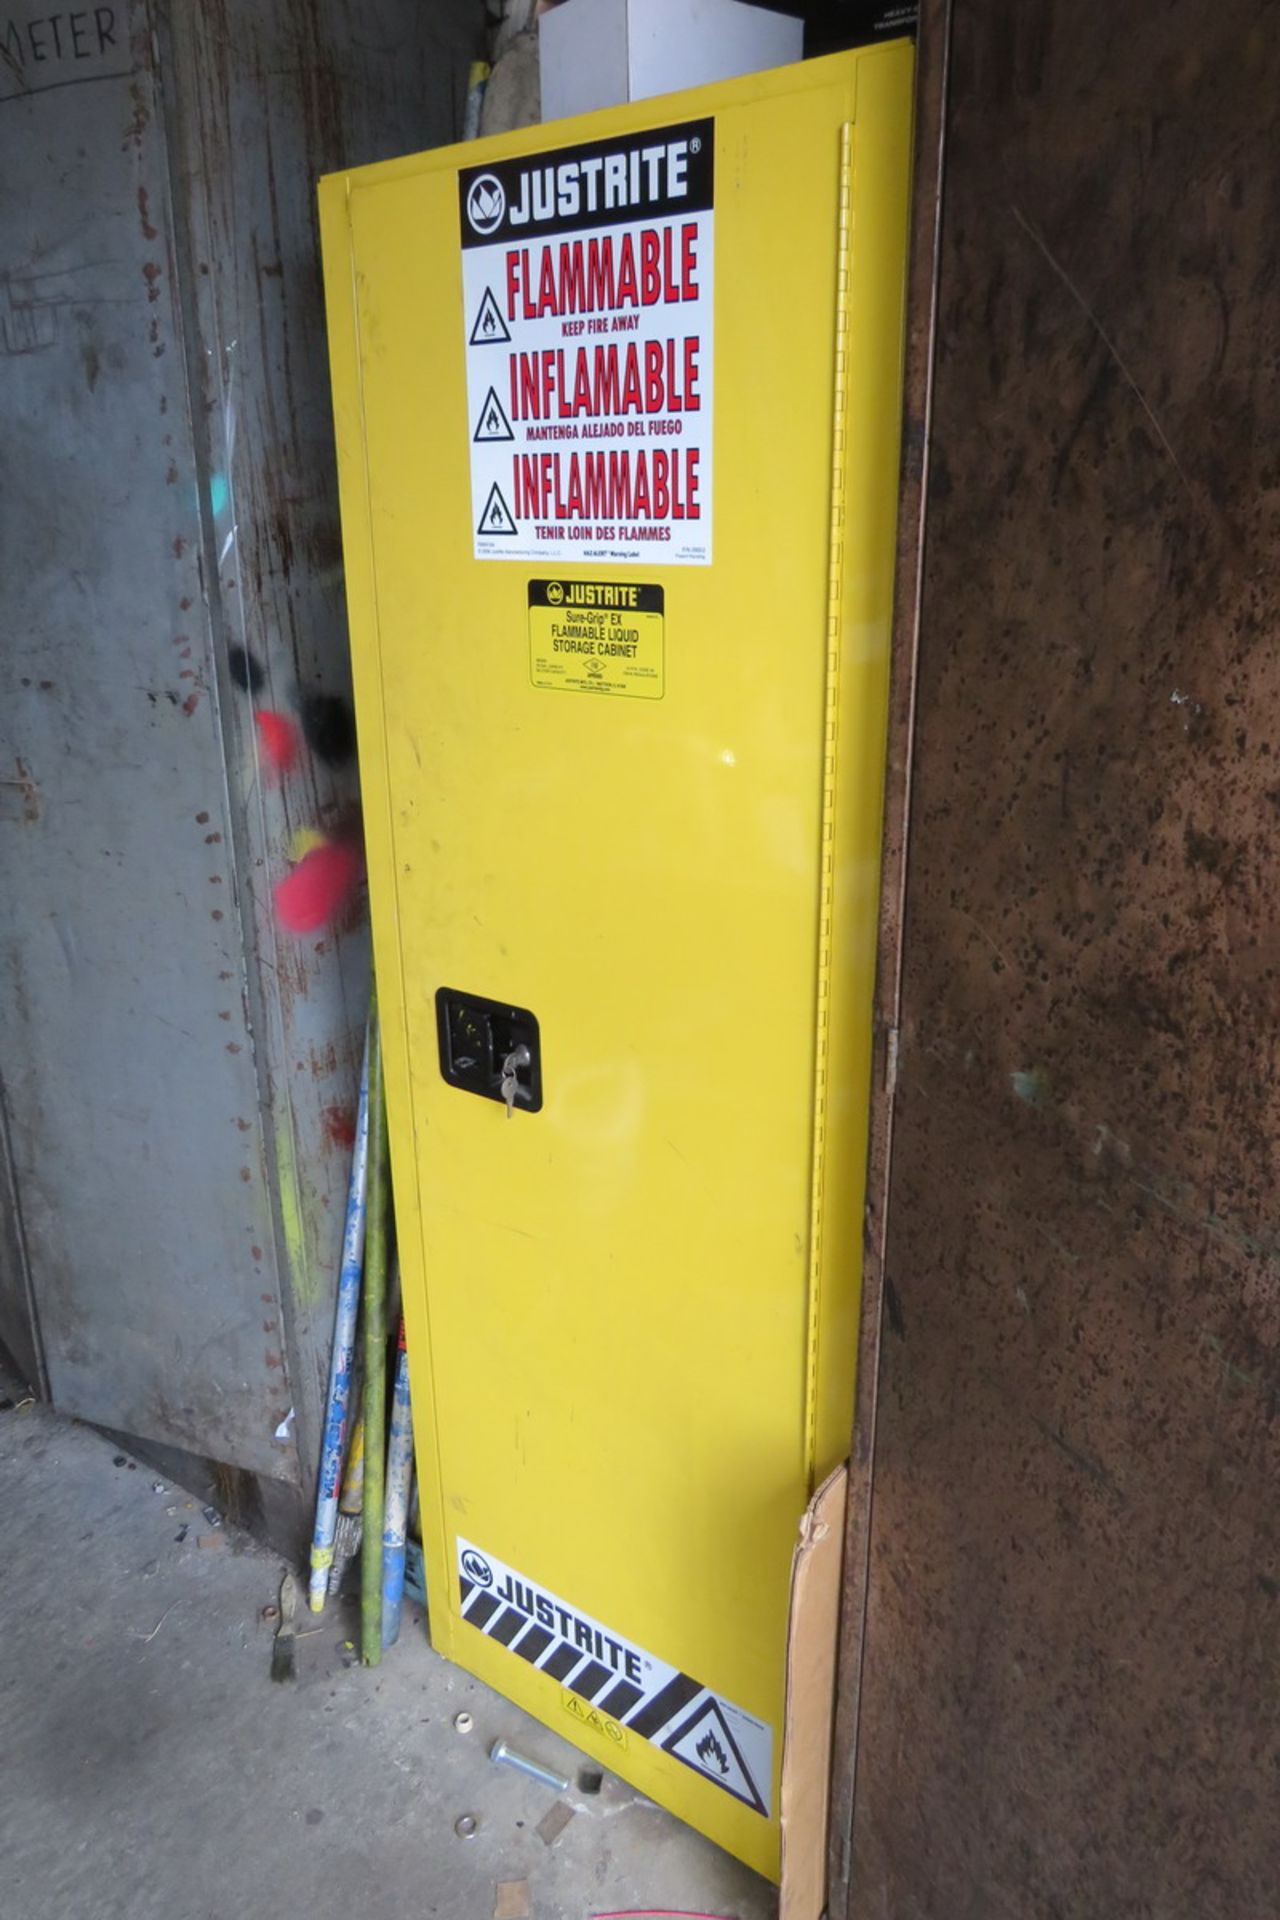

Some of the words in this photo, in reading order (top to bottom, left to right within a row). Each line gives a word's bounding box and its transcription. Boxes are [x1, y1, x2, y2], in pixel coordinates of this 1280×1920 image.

[505, 222, 699, 322] FLAMMABLE
[561, 321, 585, 337] KEEP
[587, 318, 609, 333] FIRE
[611, 314, 640, 331] AWAY
[509, 335, 701, 421] INFLAMABLE
[526, 424, 579, 441] MANTENGA
[581, 422, 625, 438] ALEJADO
[627, 421, 646, 437] DEL
[649, 419, 682, 436] FUEGO
[512, 447, 700, 521] INFLAMMABLE
[535, 526, 565, 541] TENIR
[567, 527, 592, 541] LOIN
[596, 527, 615, 541] DES
[618, 527, 671, 541] FLAMMES
[611, 612, 622, 625] EX
[551, 624, 606, 641] FLAMMABLE
[608, 629, 639, 643] LIQUID
[553, 639, 596, 655] STORAGE
[598, 642, 638, 658] CABINET
